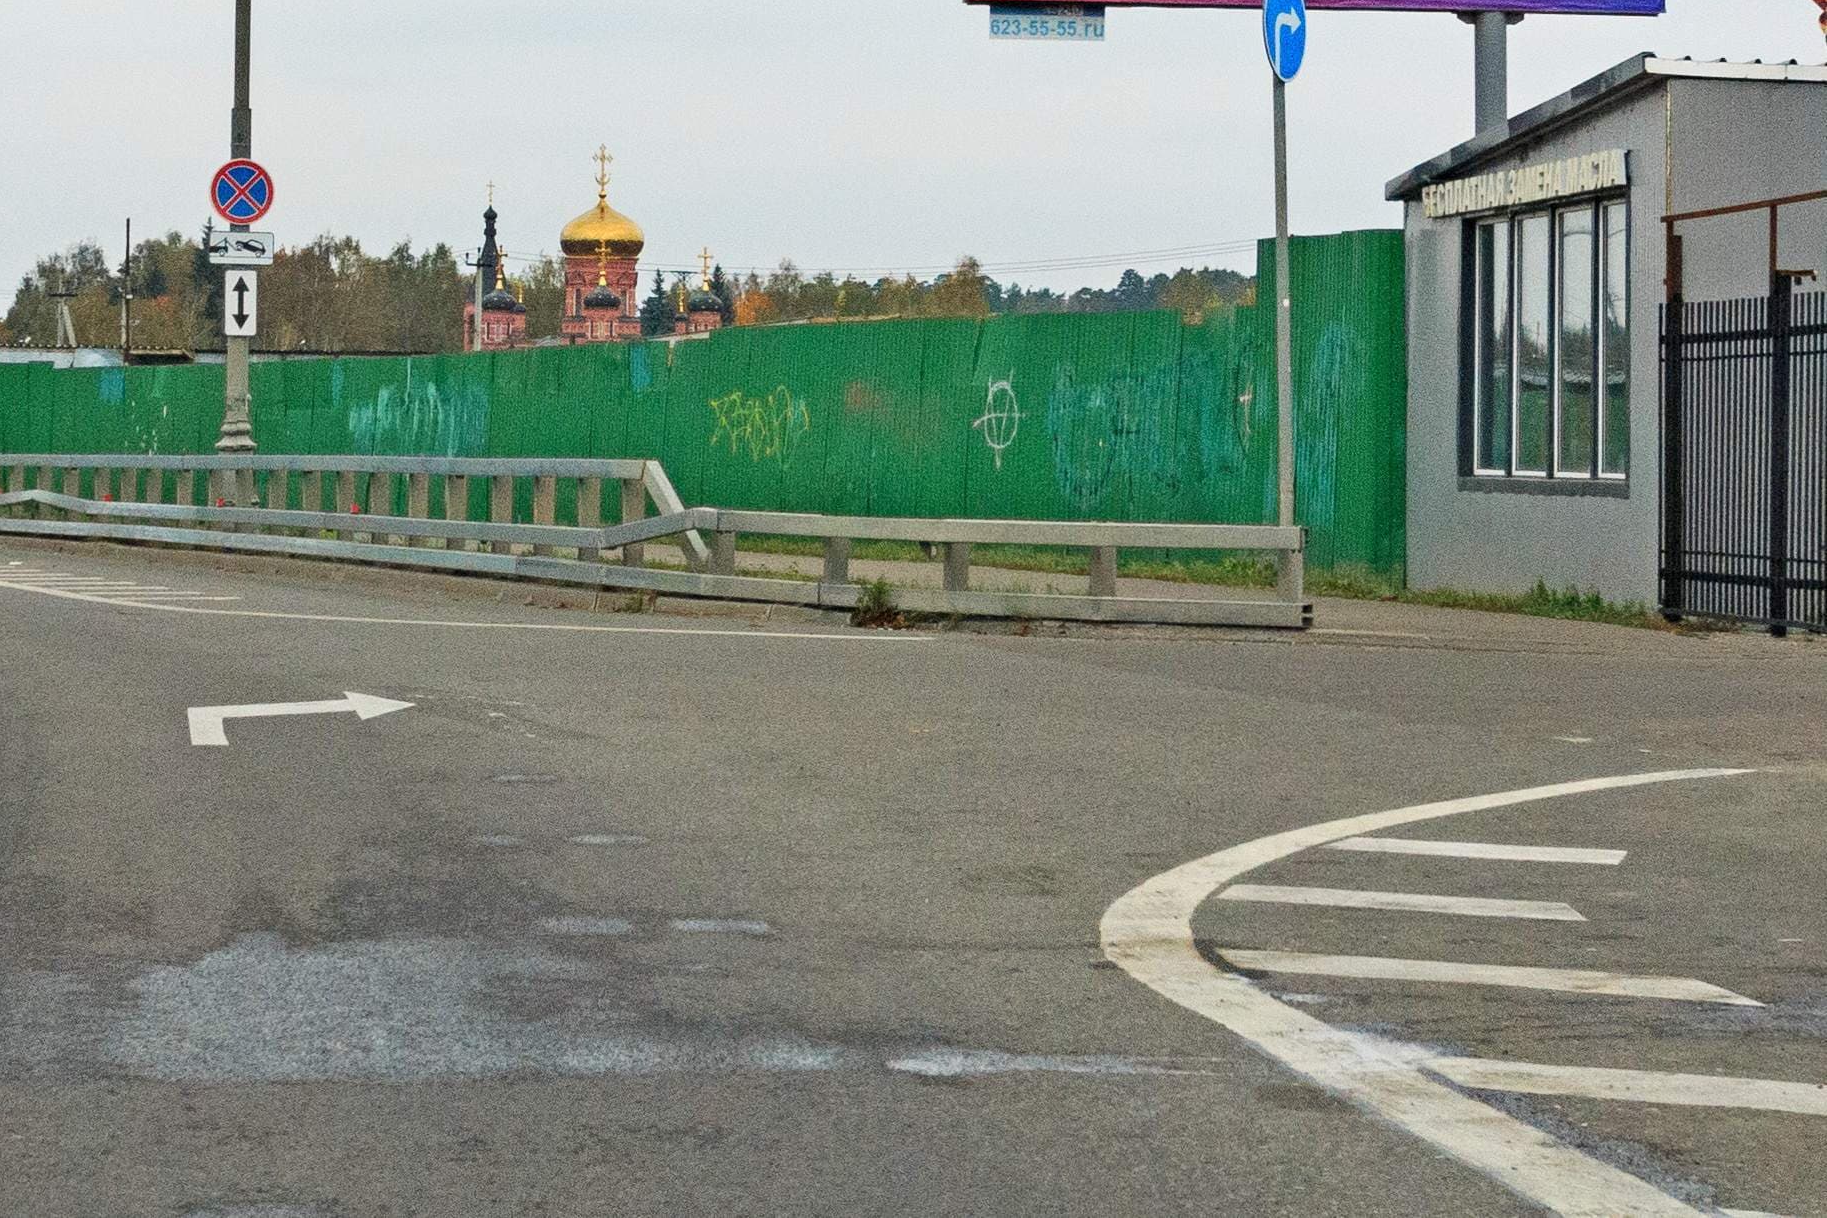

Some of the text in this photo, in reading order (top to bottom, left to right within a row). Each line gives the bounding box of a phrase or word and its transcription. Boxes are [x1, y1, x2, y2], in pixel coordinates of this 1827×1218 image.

[1422, 149, 1622, 218] БЕСПЛАТНАЯ ЗАМЕНА МАСЛА
